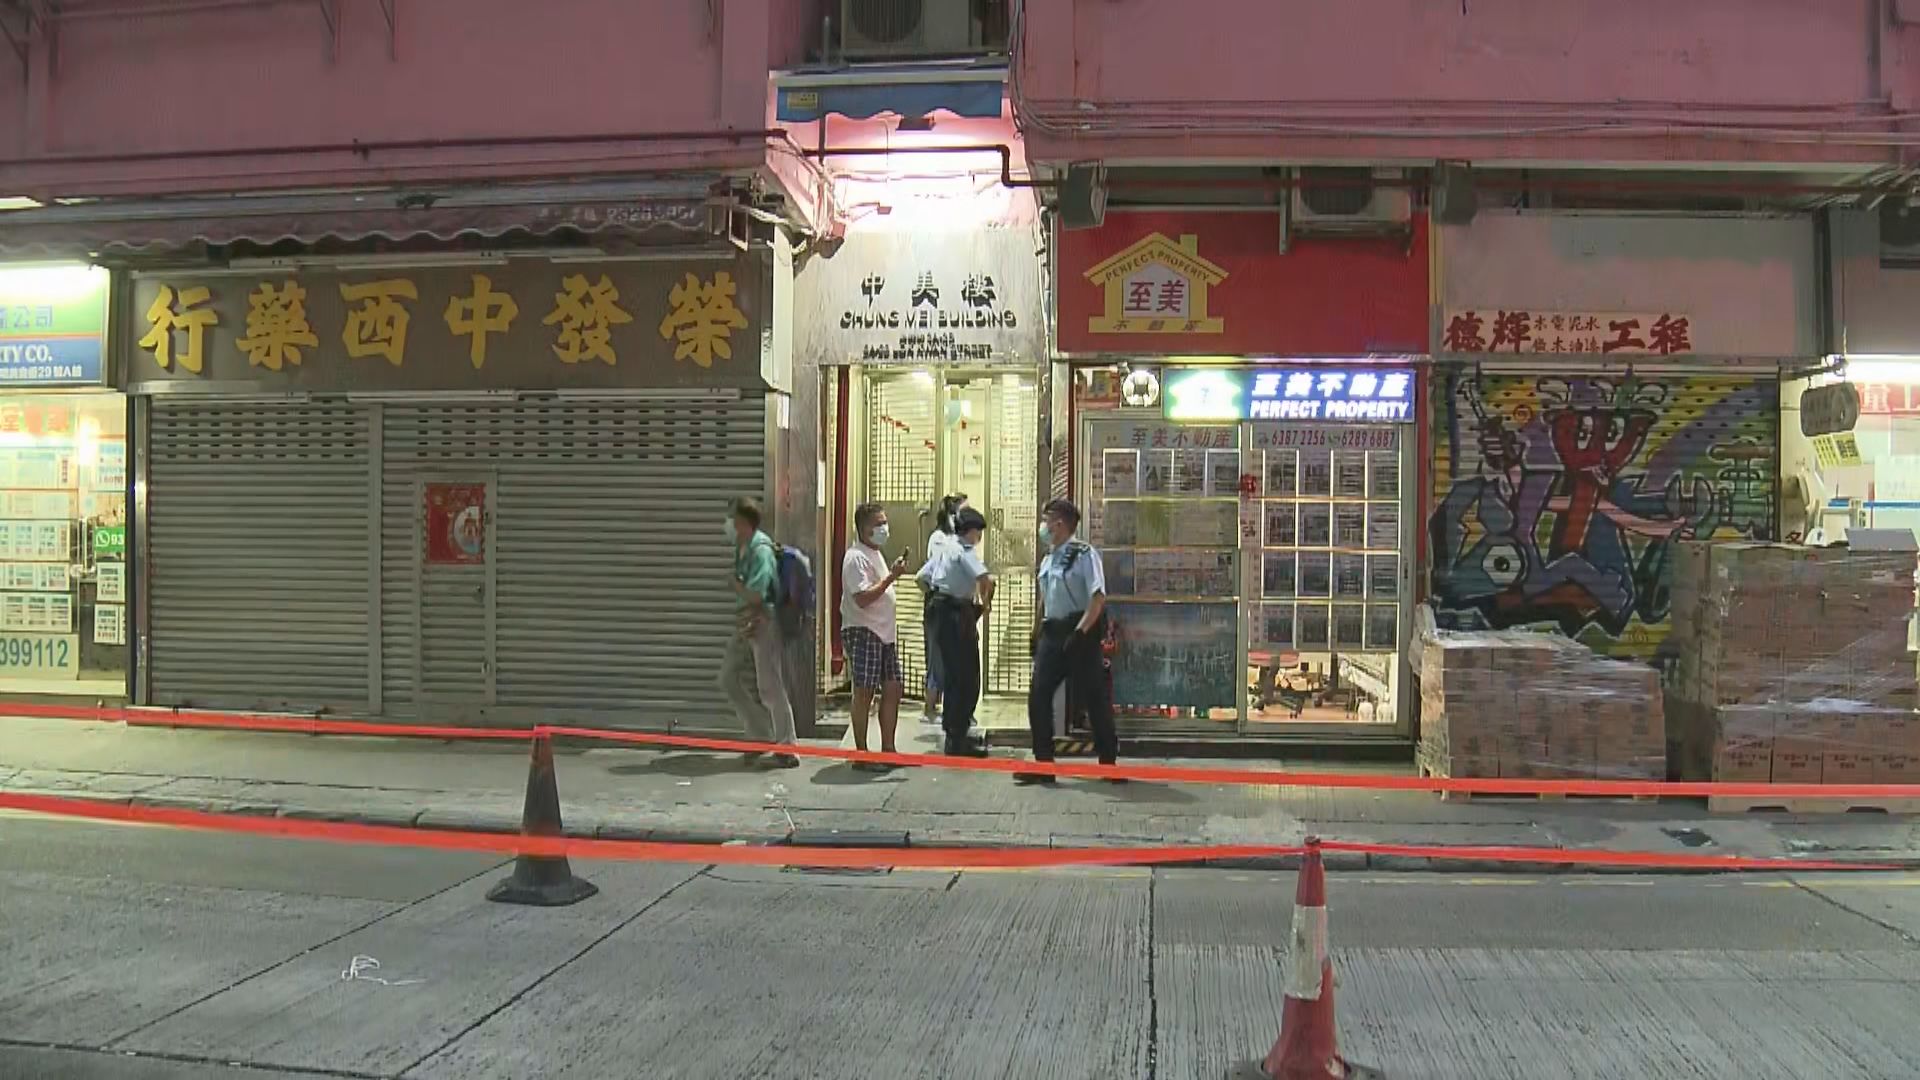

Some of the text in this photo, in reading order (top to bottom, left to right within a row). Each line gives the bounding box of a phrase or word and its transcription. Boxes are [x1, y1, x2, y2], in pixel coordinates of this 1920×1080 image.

[1105, 249, 1210, 281] PERFECT PROPERTY
[860, 271, 997, 306] 中美樓
[1125, 280, 1185, 313] 至美
[840, 310, 1017, 329] CHUNG MEI BUILDING
[1602, 313, 1691, 355] 工程
[25, 344, 53, 362] CO.
[1249, 399, 1410, 419] PERFECT PROPERTY
